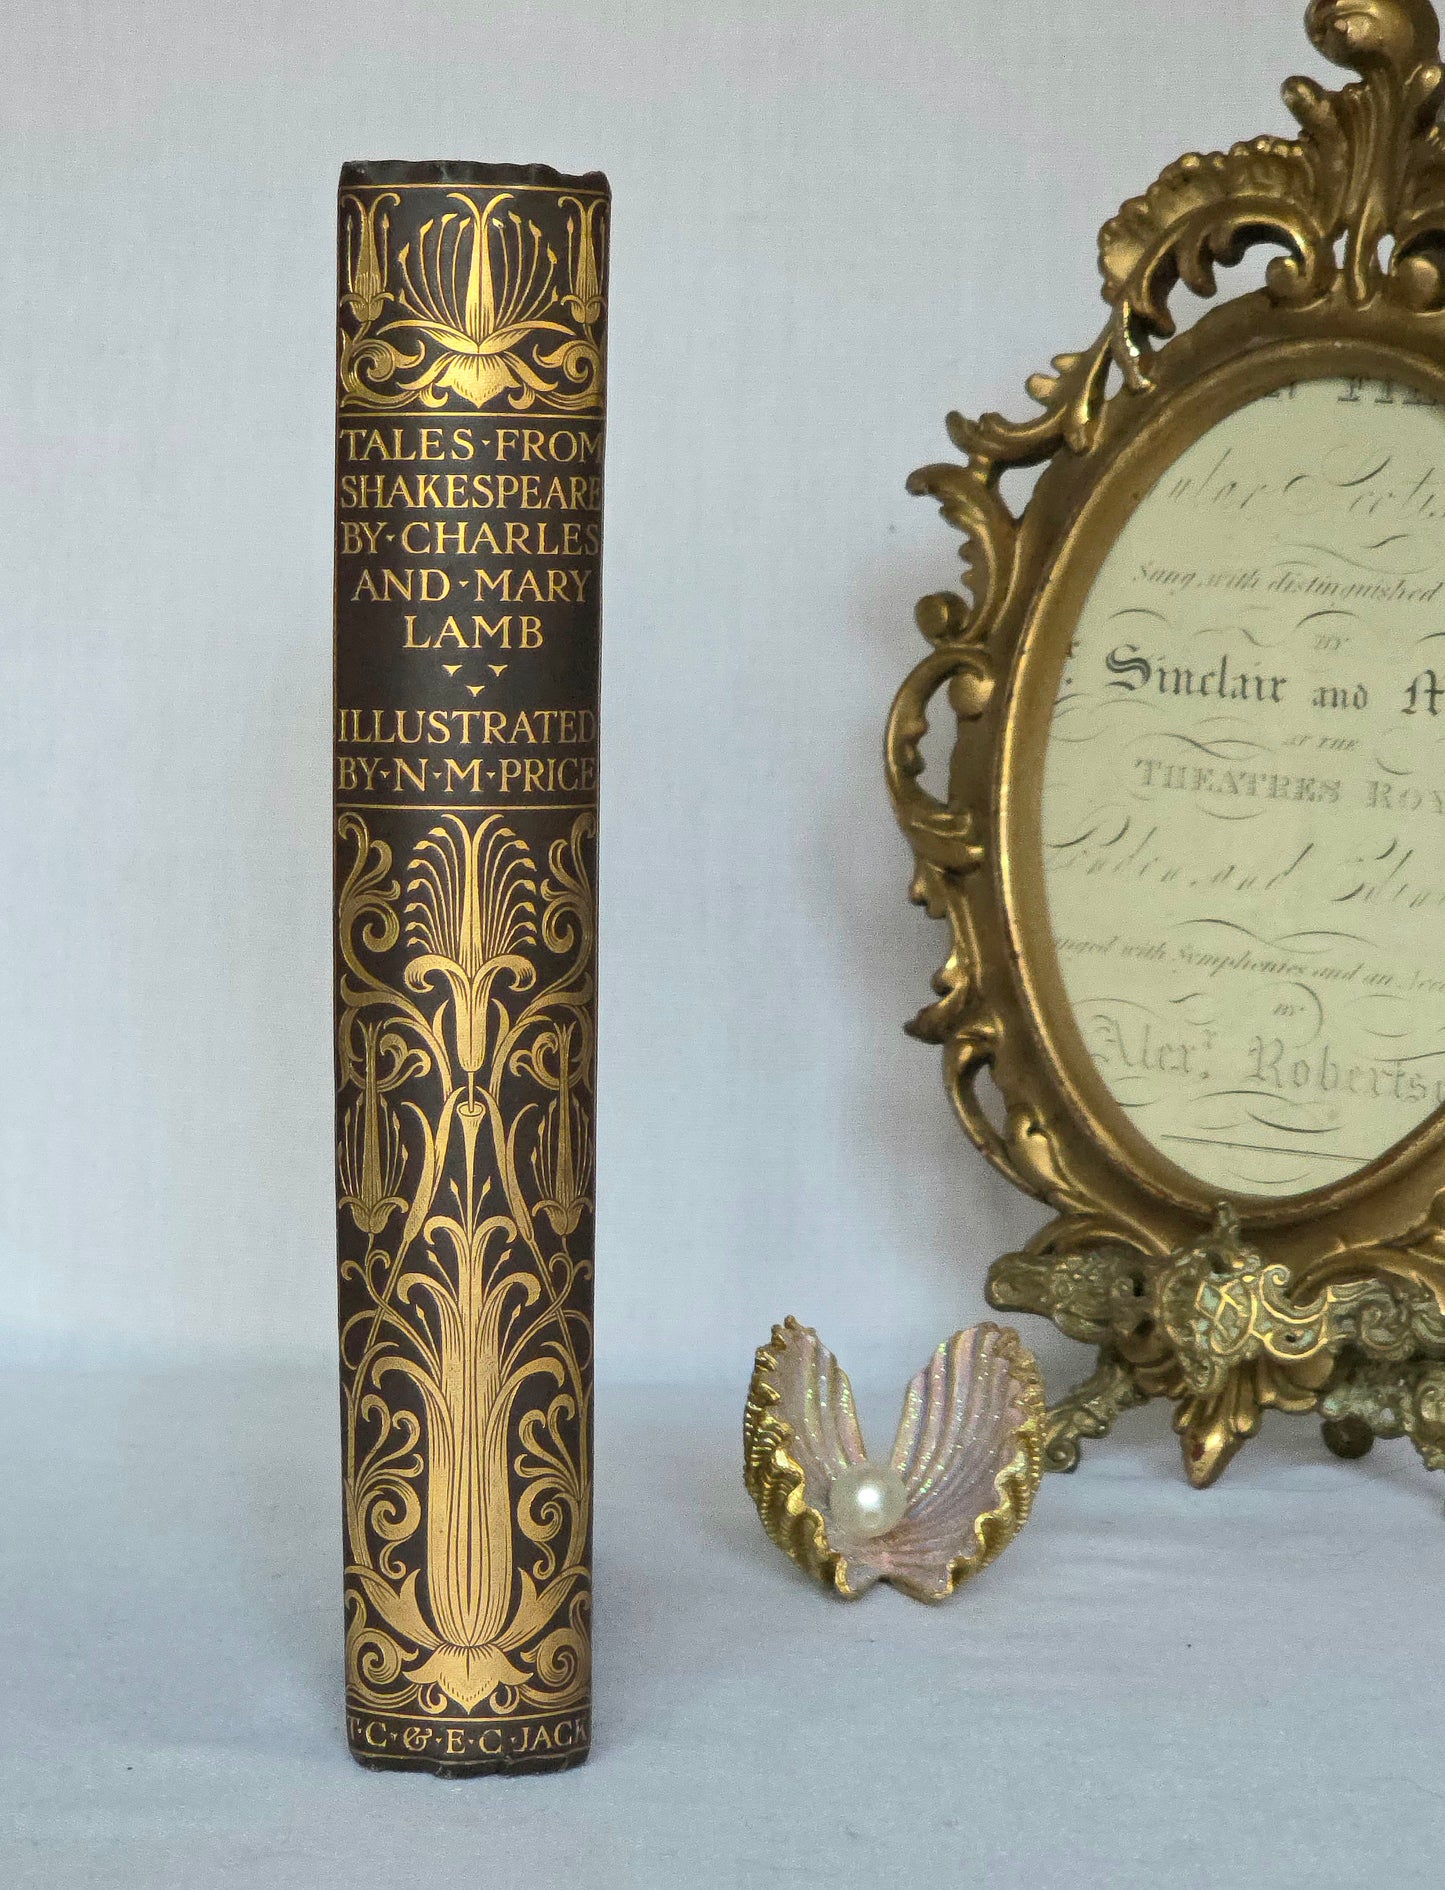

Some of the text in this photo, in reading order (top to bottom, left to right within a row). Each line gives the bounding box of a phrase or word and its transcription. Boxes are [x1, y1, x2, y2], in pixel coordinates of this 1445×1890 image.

[340, 428, 602, 463] TALES FROM
[340, 474, 601, 510] SHAKESPEARE
[340, 521, 599, 556] BY CHARLES
[351, 568, 592, 602] AND MARY
[1267, 570, 1444, 603] distinguished
[402, 615, 543, 649] LAMB
[1104, 644, 1289, 703] Sinclair
[1311, 682, 1369, 710] and
[338, 708, 596, 744] ILLUSTRATED
[337, 756, 378, 791] BY
[499, 758, 596, 792] PRICE
[1134, 757, 1342, 805] THEATRES
[513, 1718, 590, 1752] JACK
